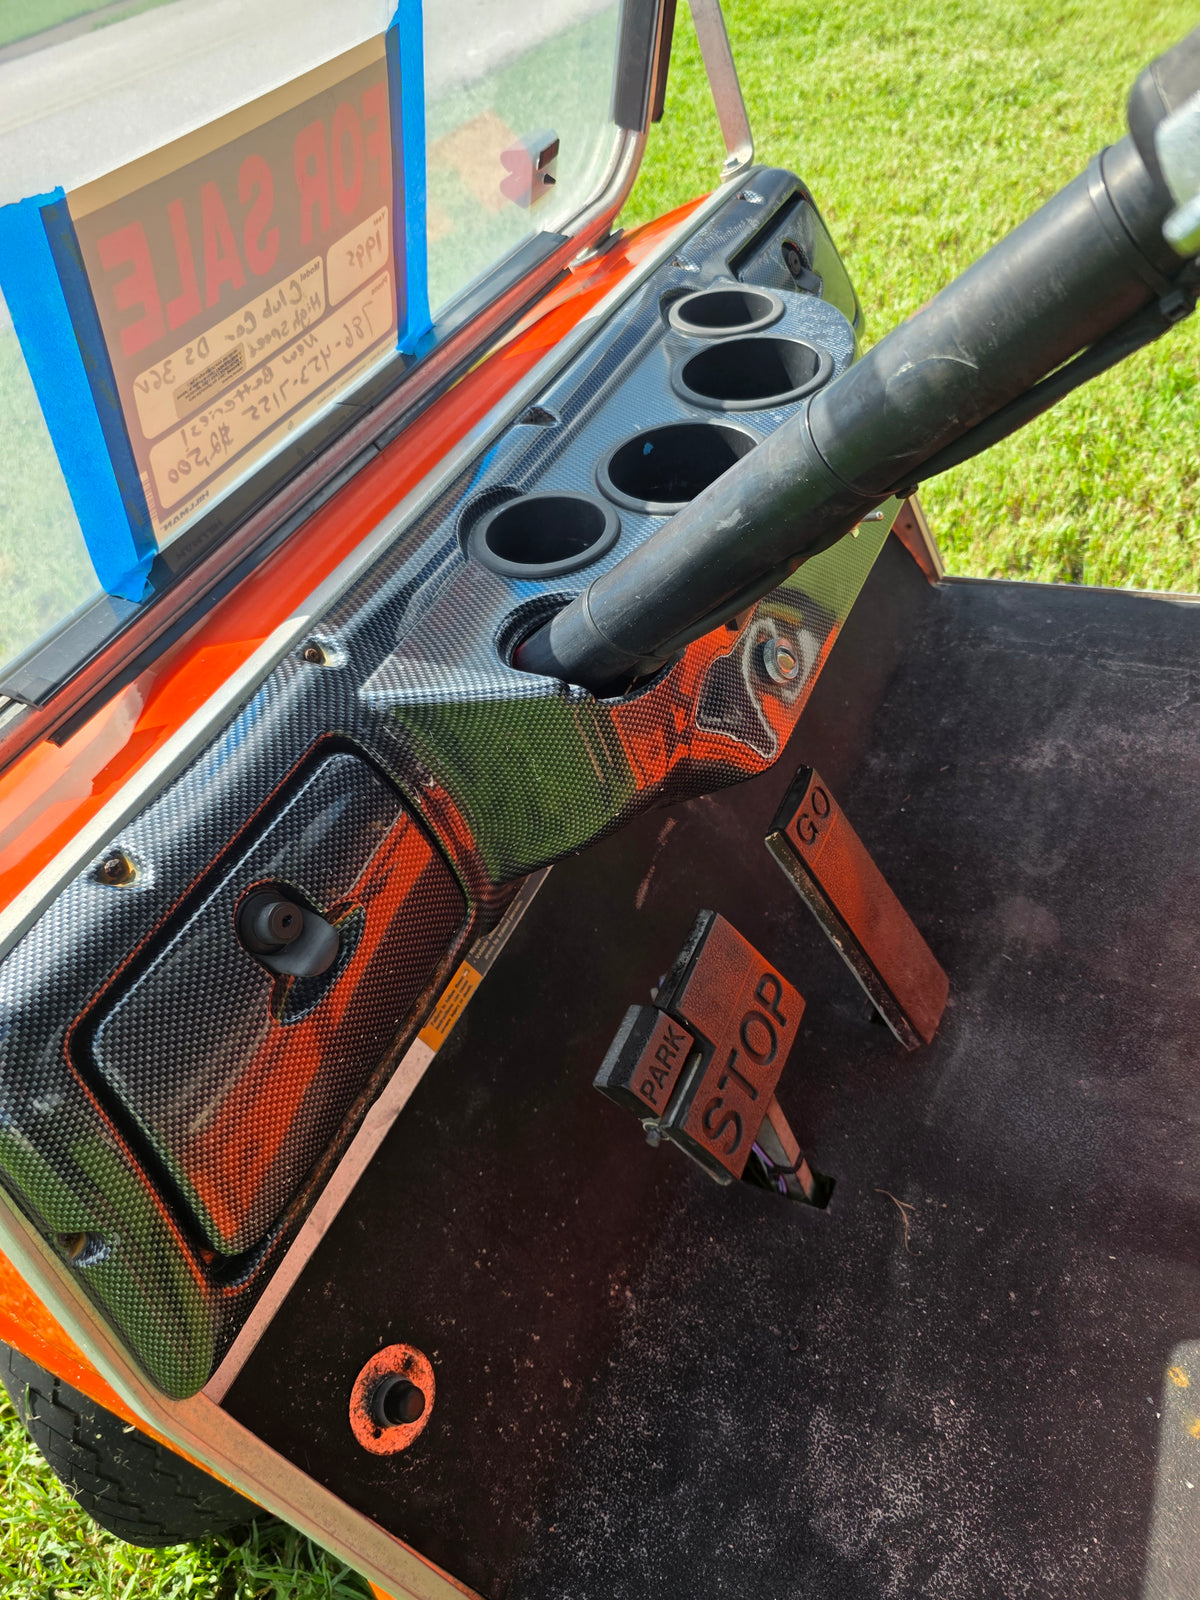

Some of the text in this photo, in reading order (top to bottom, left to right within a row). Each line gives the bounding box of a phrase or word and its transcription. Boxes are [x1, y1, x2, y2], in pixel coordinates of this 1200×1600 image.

[796, 786, 831, 846] GO
[639, 1024, 686, 1107] PARK
[704, 972, 788, 1156] STOP
